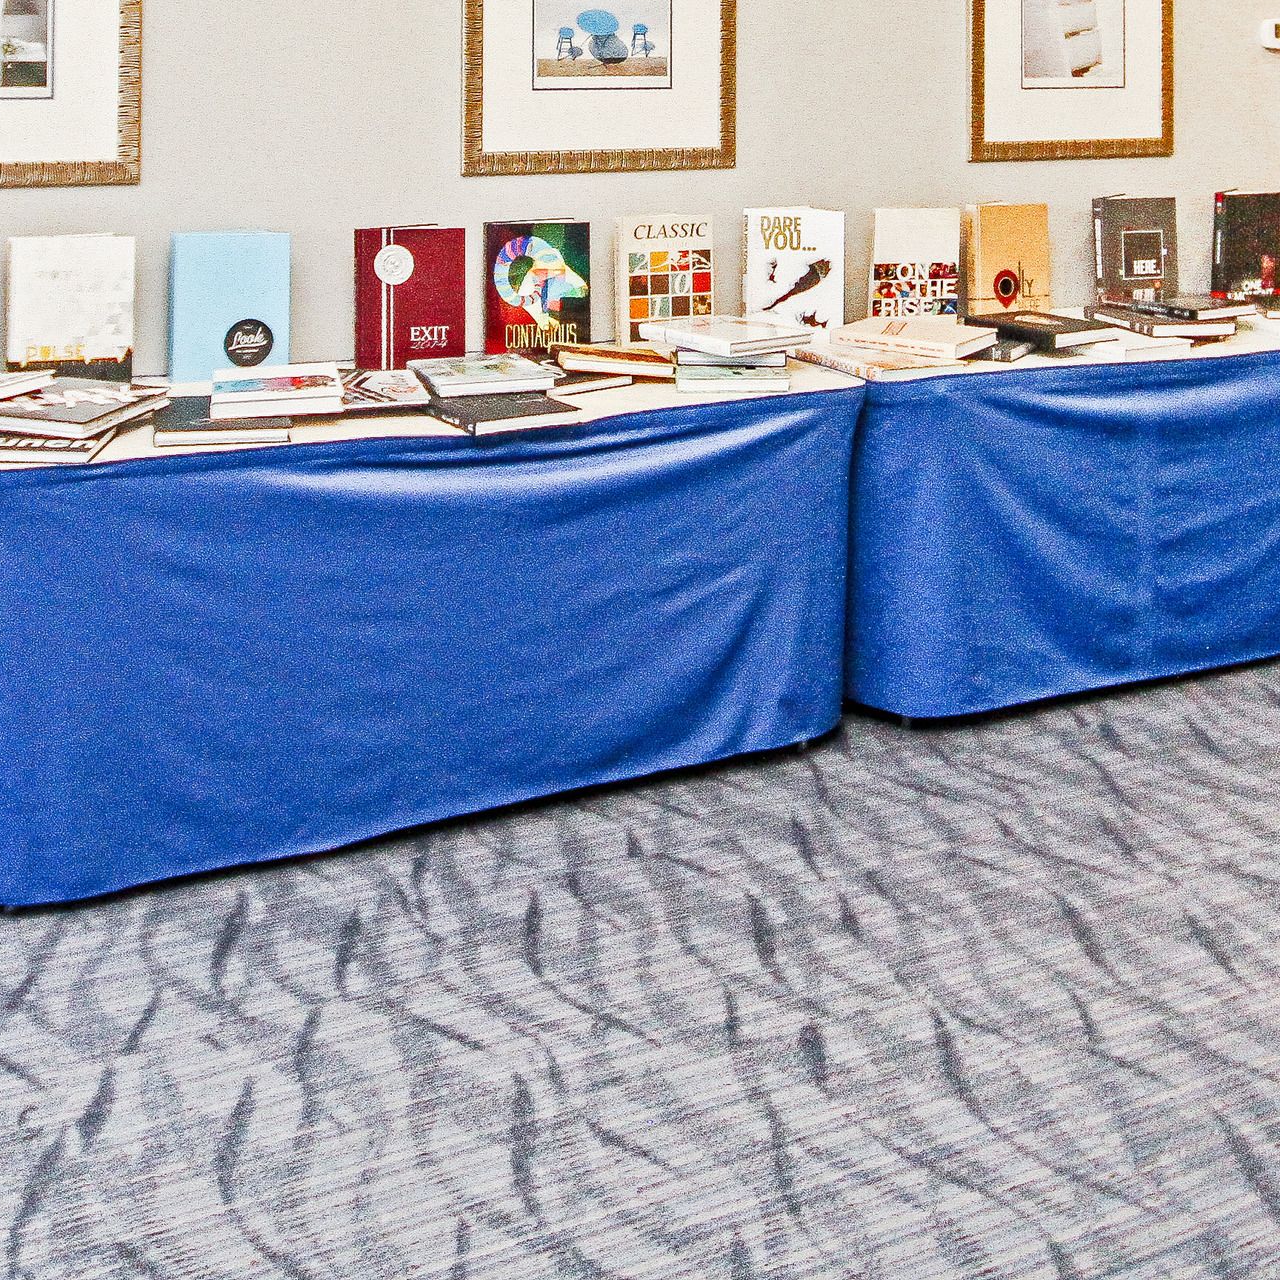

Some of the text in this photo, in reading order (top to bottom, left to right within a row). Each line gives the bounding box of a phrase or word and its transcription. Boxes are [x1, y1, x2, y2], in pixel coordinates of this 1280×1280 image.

[633, 222, 708, 240] CLASSIC
[760, 215, 802, 232] DARE
[896, 262, 929, 280] ON
[910, 279, 959, 298] THE
[880, 299, 934, 318] RISE
[228, 326, 269, 351] Look
[410, 325, 450, 341] EXIT
[505, 323, 577, 350] CONTAGIOUS
